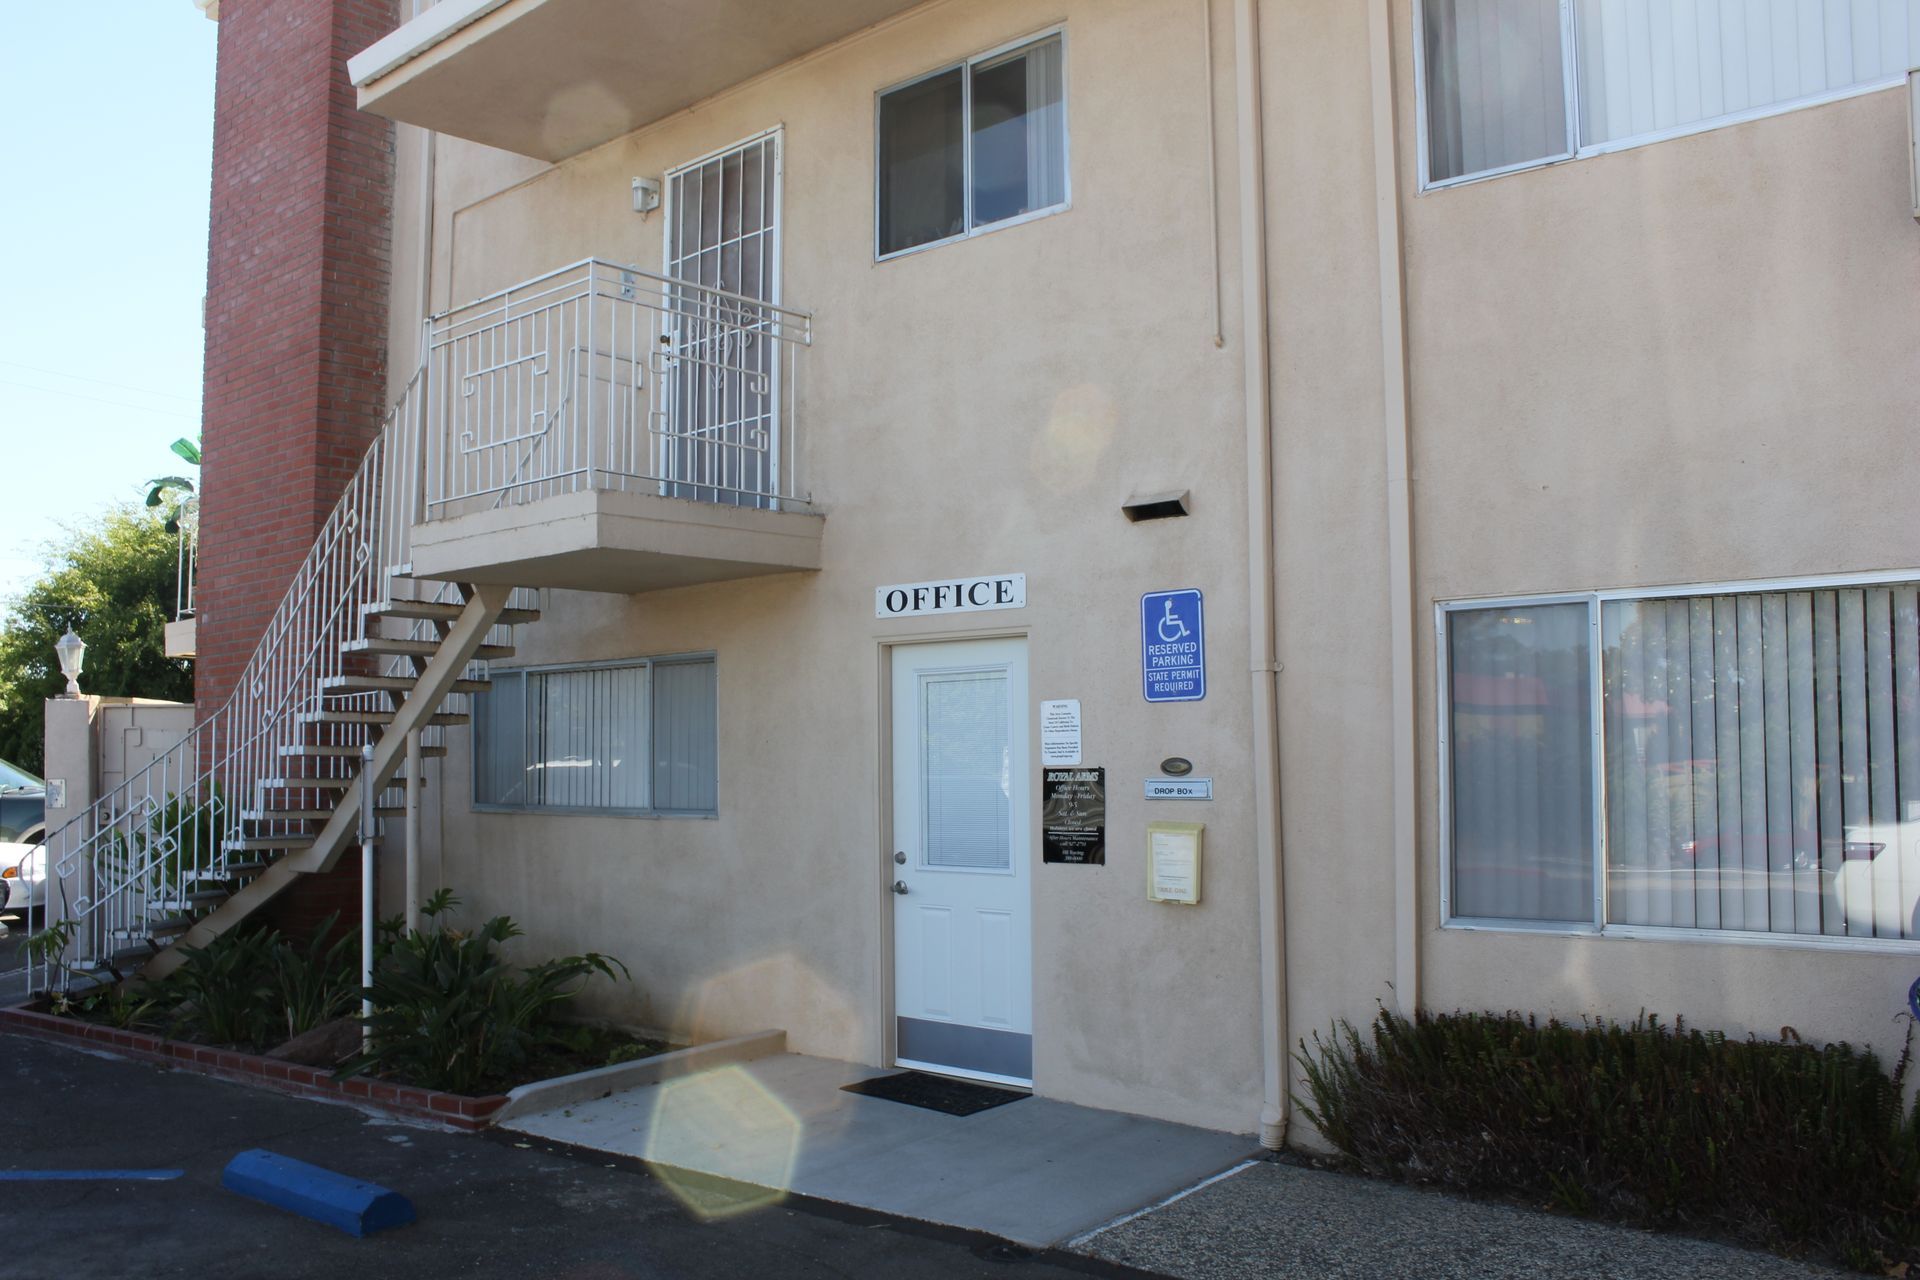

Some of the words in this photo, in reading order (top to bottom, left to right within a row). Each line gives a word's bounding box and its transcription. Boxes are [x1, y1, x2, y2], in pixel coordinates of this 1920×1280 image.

[886, 579, 1014, 613] OFFICE
[1148, 641, 1197, 656] RESERVED
[1152, 654, 1194, 667] PARKING
[1148, 671, 1169, 682] STATE
[1171, 669, 1200, 680] PERMIT
[1154, 681, 1194, 692] REQUIRED
[1047, 772, 1074, 782] ROYAL
[1074, 771, 1099, 782] ARMS
[1077, 792, 1096, 800] Friday
[1154, 787, 1175, 795] DROP
